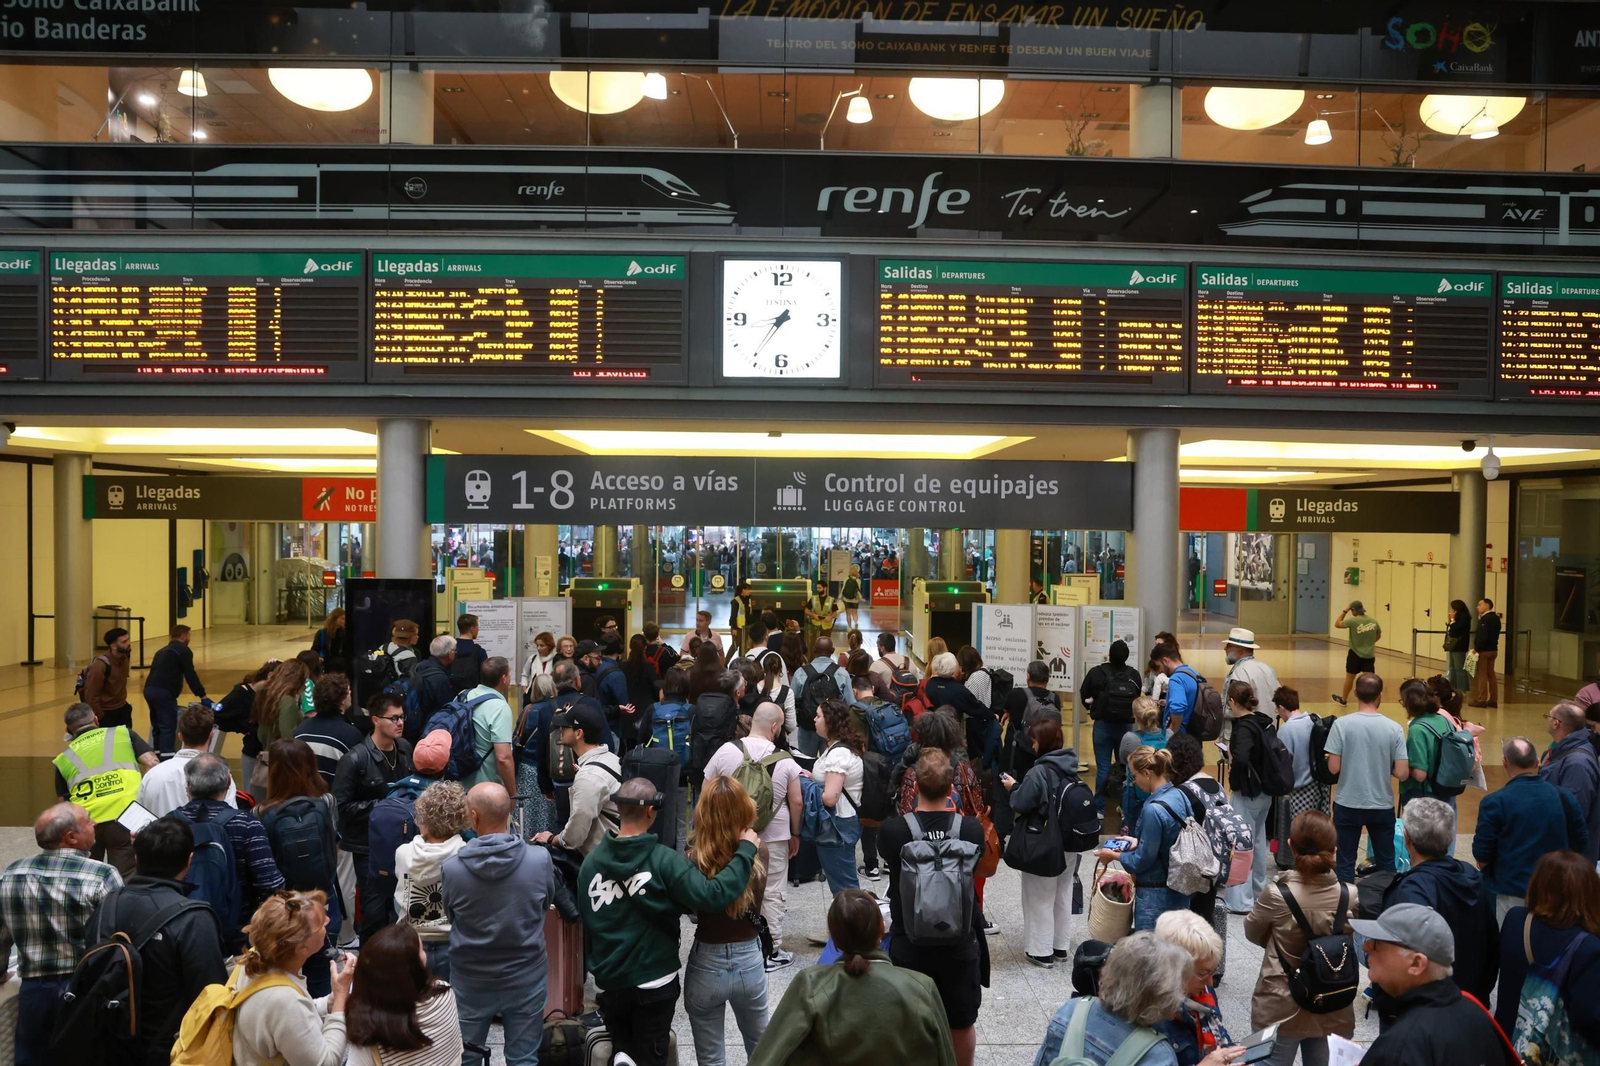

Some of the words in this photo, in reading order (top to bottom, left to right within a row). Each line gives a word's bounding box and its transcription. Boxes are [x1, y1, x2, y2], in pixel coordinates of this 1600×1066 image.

[718, 0, 756, 21] LA
[900, 1, 939, 26] DE
[945, 2, 1065, 29] ENSAYAR
[1072, 5, 1109, 31] UN
[1115, 3, 1206, 33] SUEÑO
[34, 16, 147, 40] Banderas
[1384, 15, 1497, 55] SOHO
[766, 39, 812, 50] TEATRO
[815, 40, 838, 50] DEL
[841, 41, 874, 51] SOHO
[877, 41, 946, 53] CAIXABANK
[949, 44, 956, 53] Y
[959, 43, 996, 54] RENFE
[999, 44, 1013, 54] TE
[1017, 45, 1063, 55] DESEAN
[1066, 46, 1082, 56] UN
[1086, 47, 1117, 57] BUEN
[1119, 48, 1153, 58] VIAJE
[1450, 61, 1494, 73] CaixaBank
[517, 180, 565, 200] renfe
[816, 171, 971, 230] renfe
[1000, 187, 1041, 219] Tu
[1049, 191, 1131, 219] tren
[1502, 208, 1547, 222] AVE
[0, 259, 33, 270] adif
[55, 257, 117, 274] Llegadas
[125, 263, 160, 271] ARRIVALS
[320, 261, 354, 272] adif
[377, 259, 439, 275] Llegadas
[447, 264, 482, 272] ARRIVALS
[644, 264, 677, 274] adif
[771, 272, 793, 287] 12
[884, 265, 933, 279] Salidas
[941, 271, 986, 280] DEPARTURES
[1146, 273, 1178, 284] adif
[1201, 272, 1248, 286] Salidas
[1256, 278, 1299, 287] DEPARTURES
[1453, 281, 1485, 292] adif
[1507, 281, 1553, 295] Salidas
[733, 312, 747, 327] 9
[816, 313, 830, 327] 3
[774, 354, 788, 368] 6
[135, 484, 201, 501] Llegadas
[511, 469, 575, 510] 1-8
[590, 470, 664, 492] Acceso
[672, 474, 685, 491] a
[693, 470, 738, 492] vías
[824, 472, 905, 494] Control
[913, 473, 941, 494] de
[949, 474, 1059, 499] equipajes
[345, 486, 366, 501] No
[136, 503, 177, 511] ARRIVALS
[345, 504, 357, 512] NO
[590, 497, 676, 511] PLATFORMS
[824, 499, 895, 512] LUGGAGE
[899, 500, 966, 513] CONTROL
[1296, 497, 1359, 515] Llegadas
[1296, 515, 1336, 524] ARRIVALS
[94, 773, 119, 783] grupo
[95, 778, 124, 790] control
